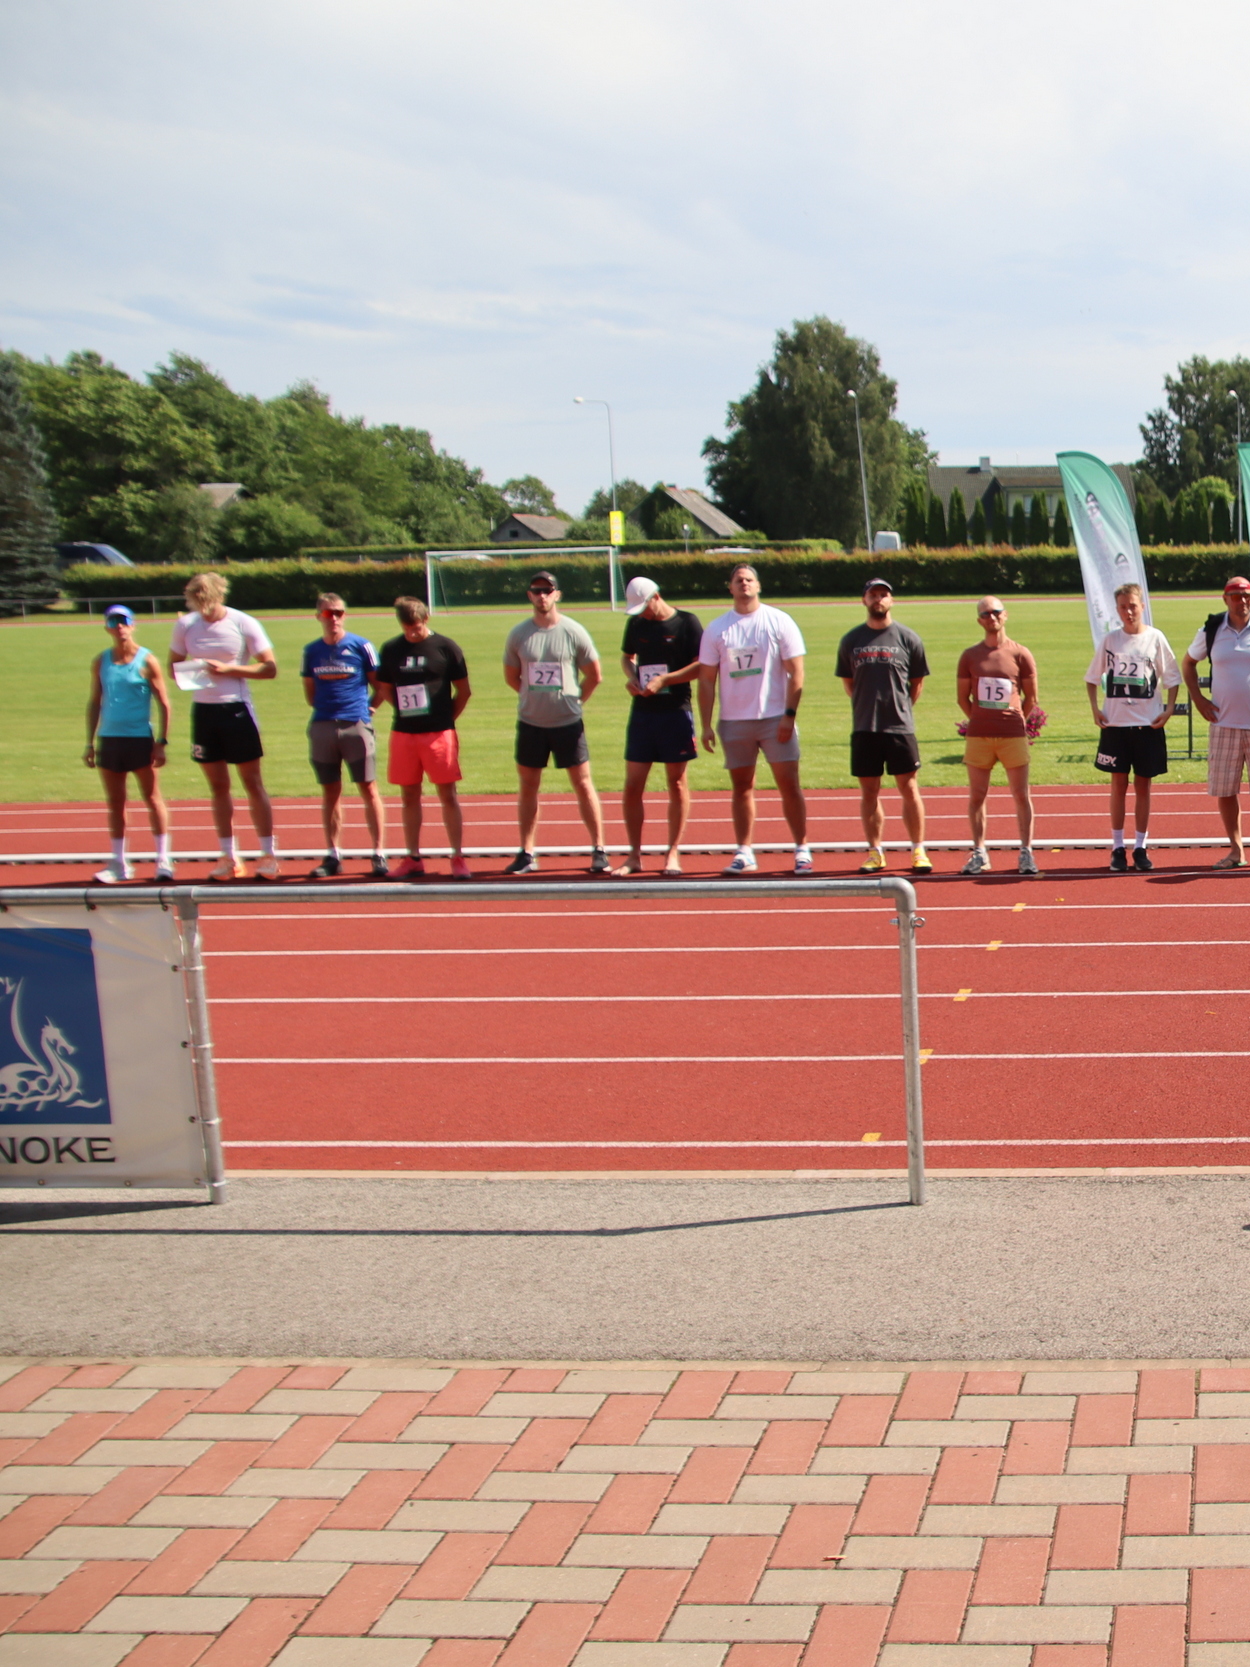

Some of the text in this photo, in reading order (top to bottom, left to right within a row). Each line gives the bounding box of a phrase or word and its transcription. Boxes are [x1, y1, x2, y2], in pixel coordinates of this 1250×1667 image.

[734, 654, 753, 670] 17
[1118, 661, 1138, 677] 22
[534, 670, 555, 685] 27
[985, 686, 1004, 701] 15
[401, 694, 419, 709] 31
